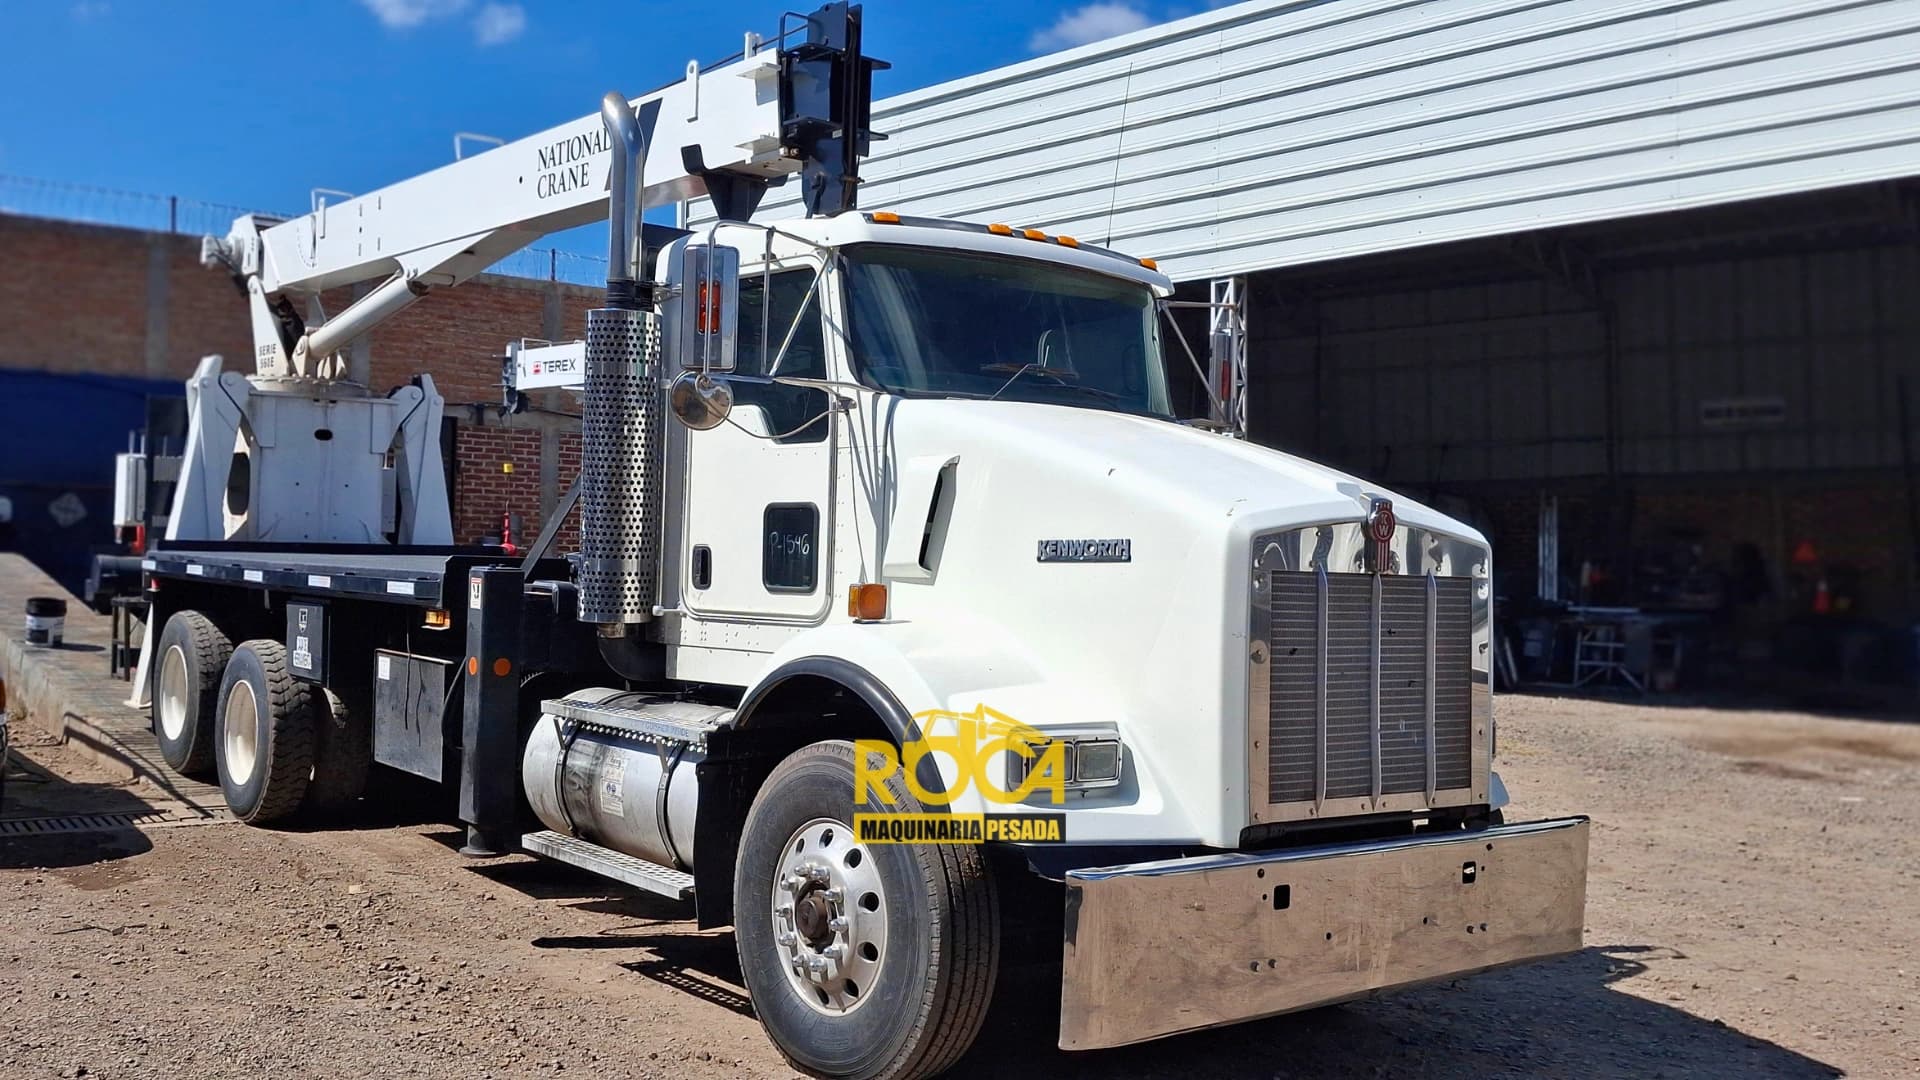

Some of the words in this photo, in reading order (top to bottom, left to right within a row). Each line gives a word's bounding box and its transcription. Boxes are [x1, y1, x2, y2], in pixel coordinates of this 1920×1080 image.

[537, 127, 612, 172] NATIONAL
[537, 162, 590, 199] CRANE
[259, 343, 276, 356] SERIE
[543, 358, 576, 373] TEREX
[1037, 539, 1131, 562] KENWORTH
